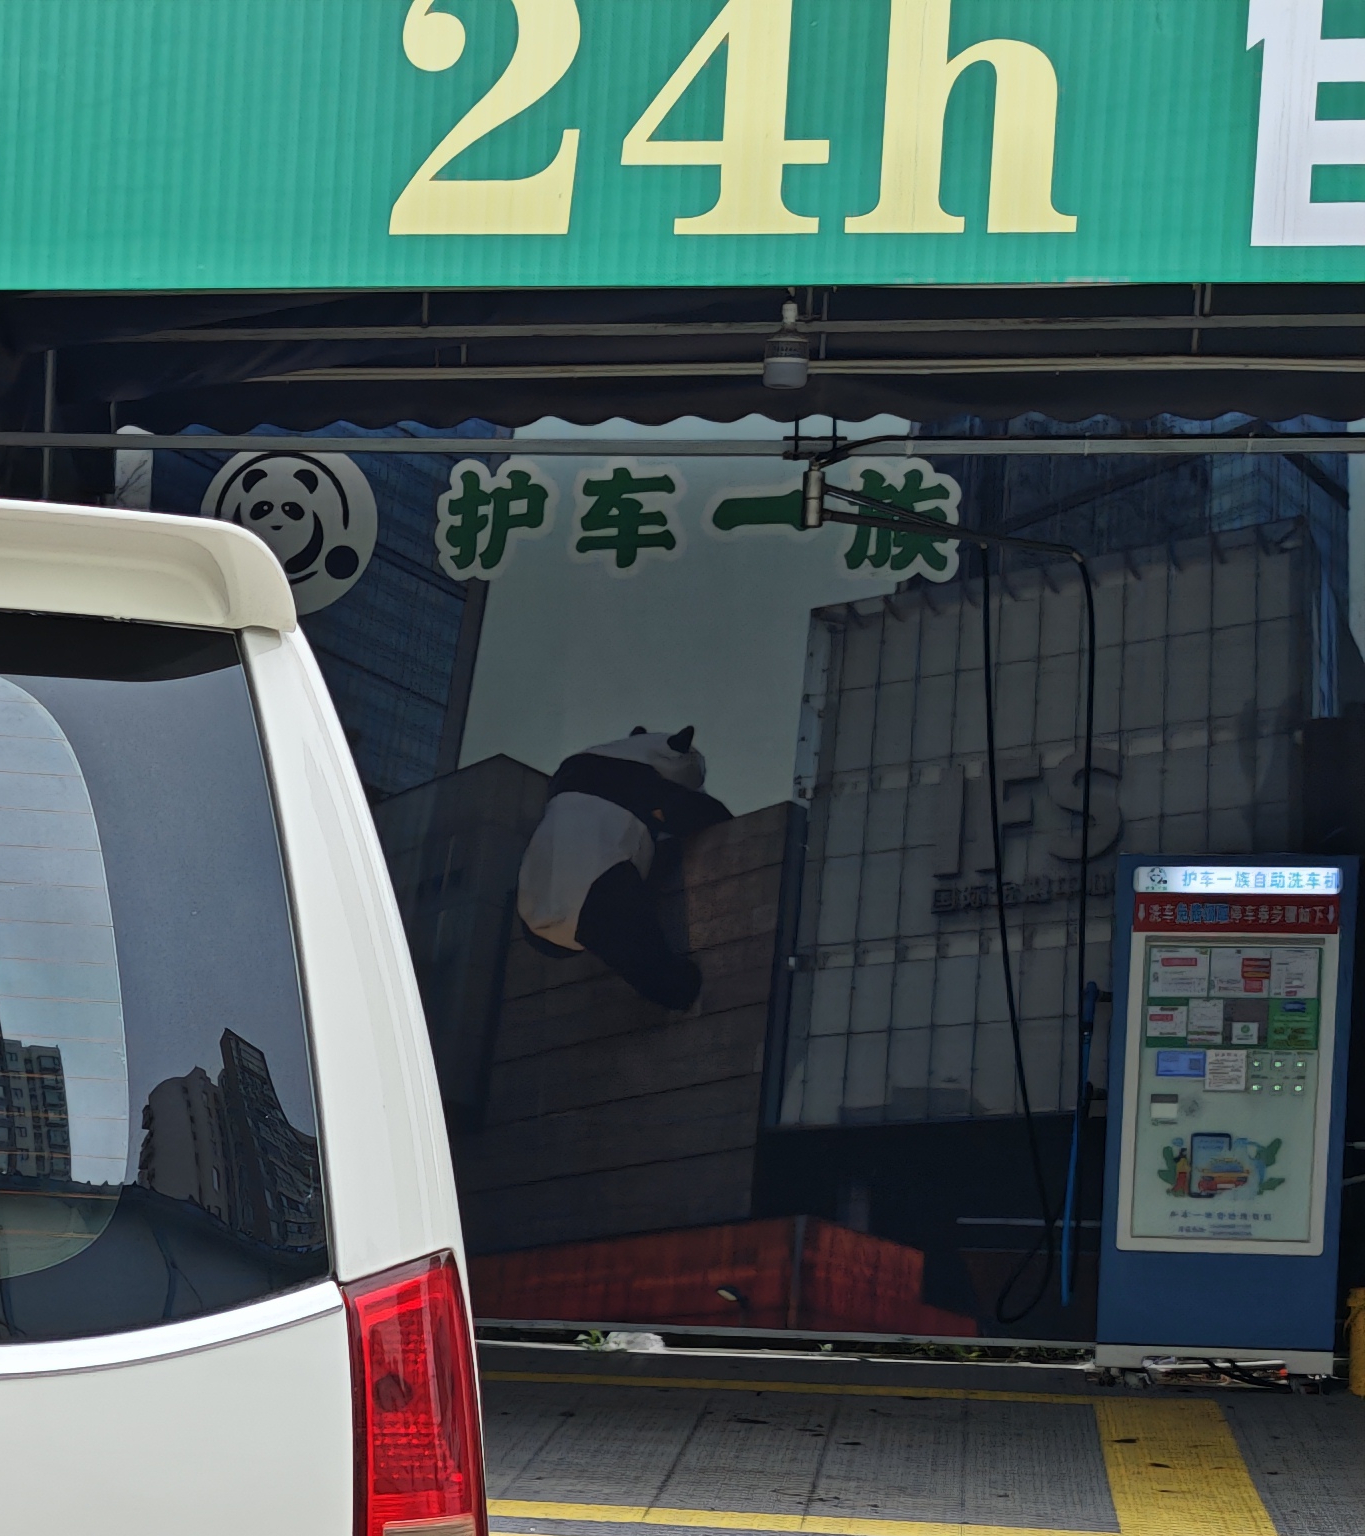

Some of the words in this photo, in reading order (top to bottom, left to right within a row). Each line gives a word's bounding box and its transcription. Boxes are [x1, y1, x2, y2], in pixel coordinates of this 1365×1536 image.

[389, 0, 1077, 234] 24h
[445, 467, 953, 571] 护车一族
